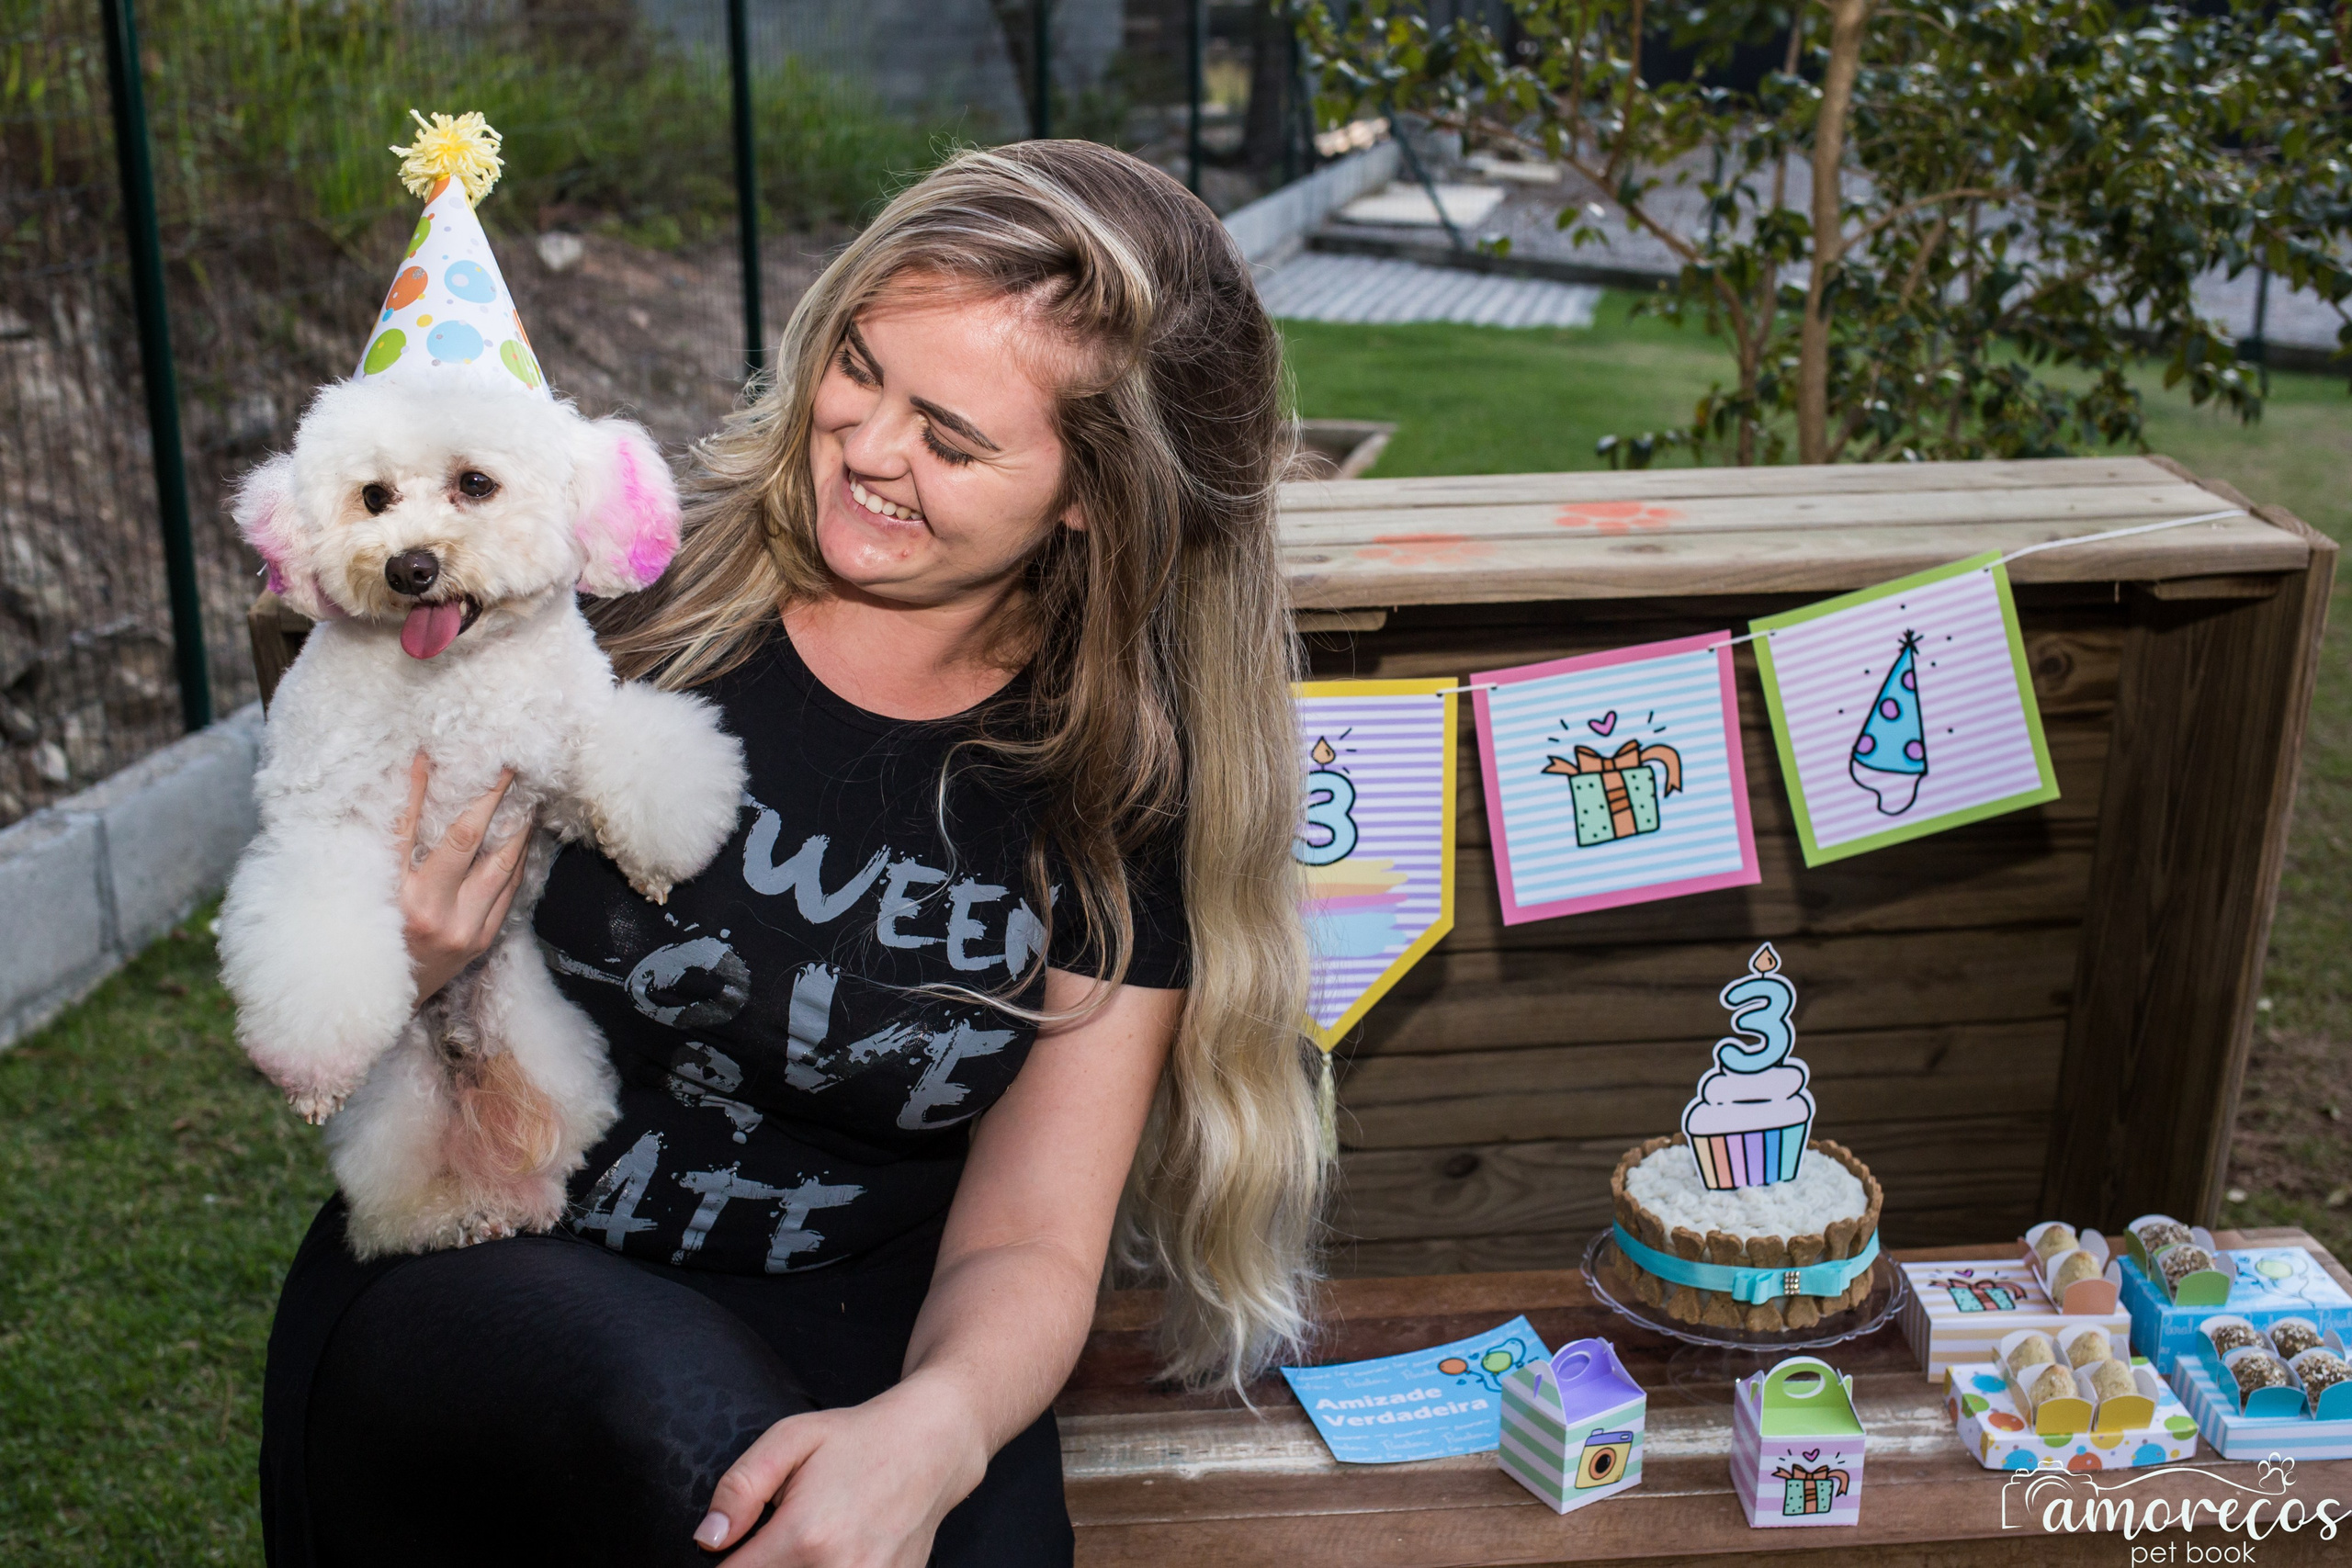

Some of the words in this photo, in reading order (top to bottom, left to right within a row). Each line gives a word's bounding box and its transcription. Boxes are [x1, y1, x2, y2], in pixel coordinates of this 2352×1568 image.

[1292, 769, 1358, 866] 3
[741, 792, 1061, 981] WEEN
[1717, 977, 1793, 1074] 3
[571, 1129, 868, 1274] ATE
[1316, 1387, 1442, 1411] Amizade
[1322, 1399, 1489, 1427] Verdadeira
